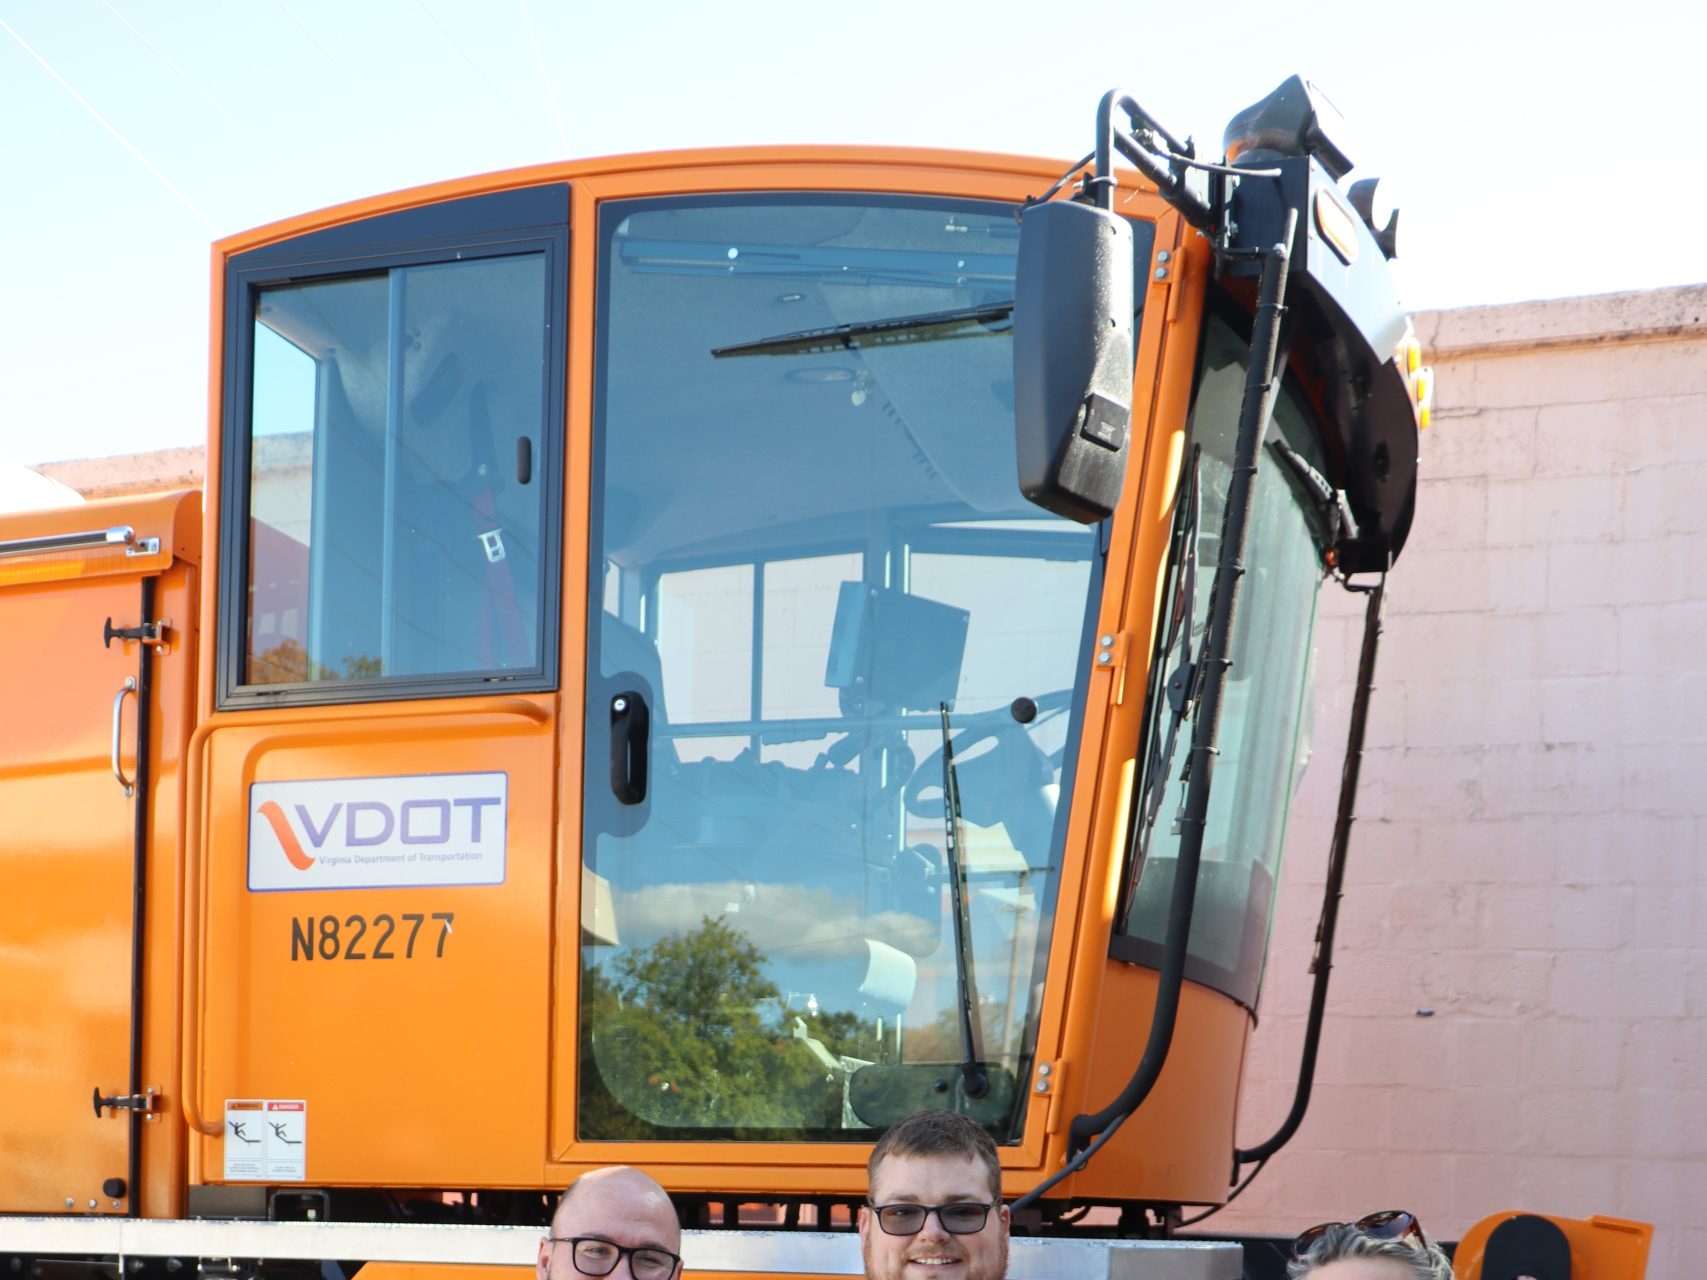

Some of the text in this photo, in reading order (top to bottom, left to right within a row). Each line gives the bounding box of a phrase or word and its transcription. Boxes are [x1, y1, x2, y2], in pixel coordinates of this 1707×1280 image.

[294, 797, 502, 848] VDOT
[319, 851, 483, 866] Virginia Department of Transportation
[291, 912, 454, 961] N82277
